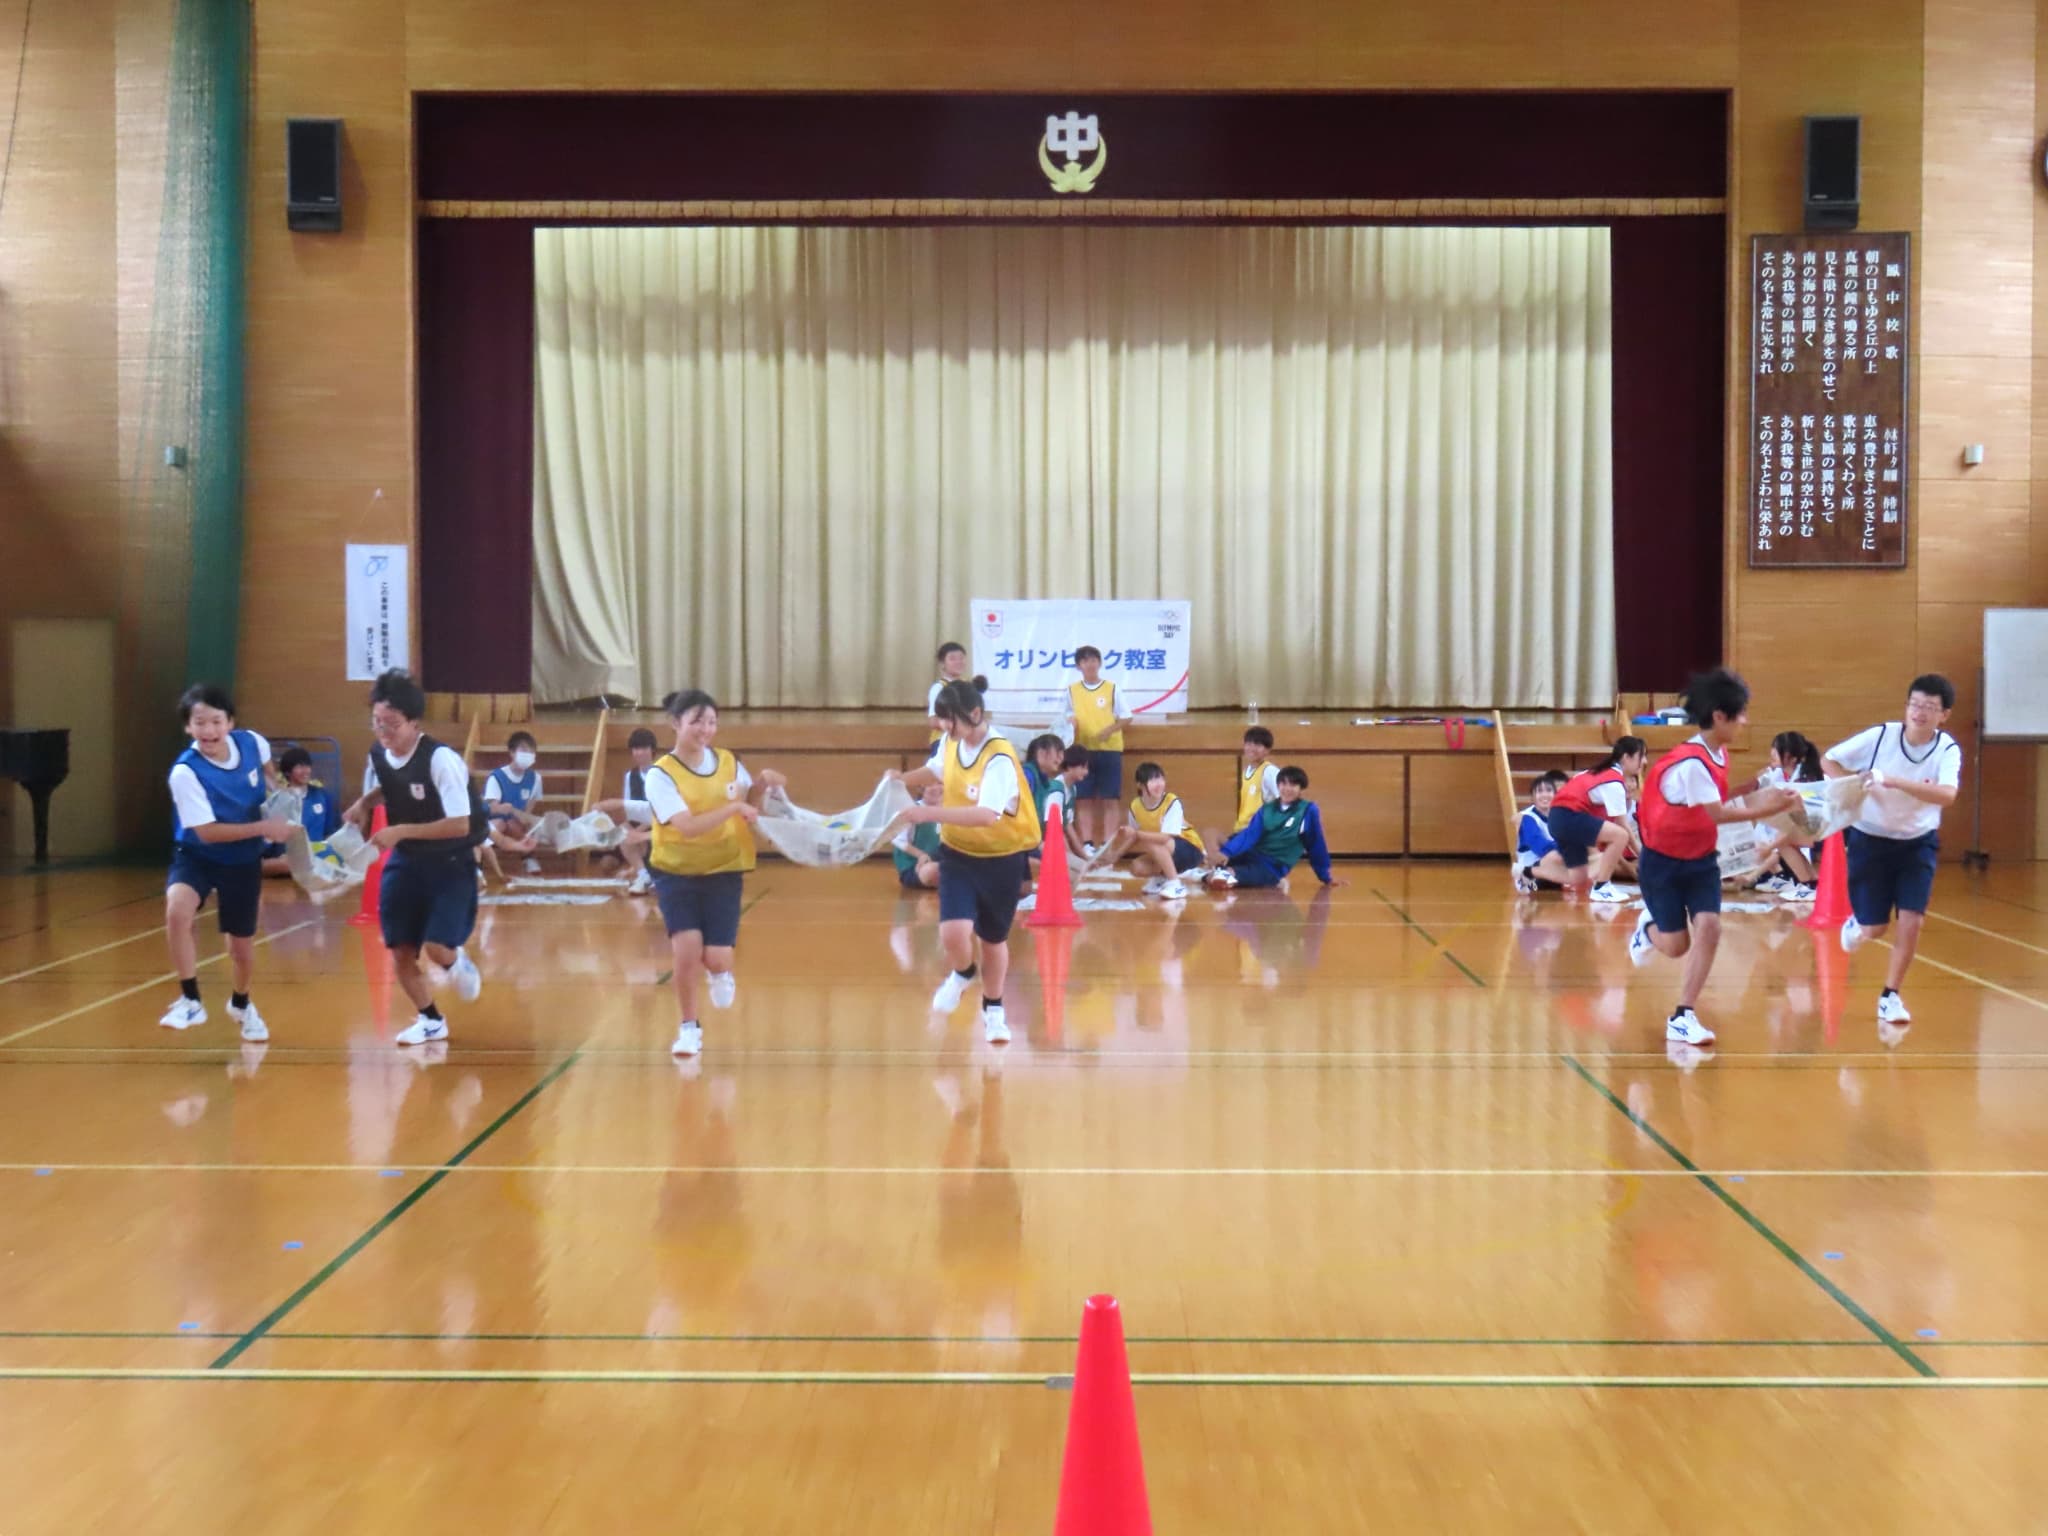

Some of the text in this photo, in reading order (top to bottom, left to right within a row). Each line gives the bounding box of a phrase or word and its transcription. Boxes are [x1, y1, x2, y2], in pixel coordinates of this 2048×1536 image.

[1760, 251, 1775, 374] その名よ常に光あれ
[1822, 251, 1837, 401] 見よ限りなき夢をのせて
[1864, 250, 1879, 374] 朝の日もゆる丘の上
[1758, 415, 1773, 550] その名よとわに栄あれ
[1800, 414, 1815, 537] 新しき世の空かけむ
[1841, 414, 1857, 510] 歌声高くわく所
[1862, 414, 1877, 549] 恵み豊けきふるさとに
[994, 648, 1167, 670] オリンピク教室
